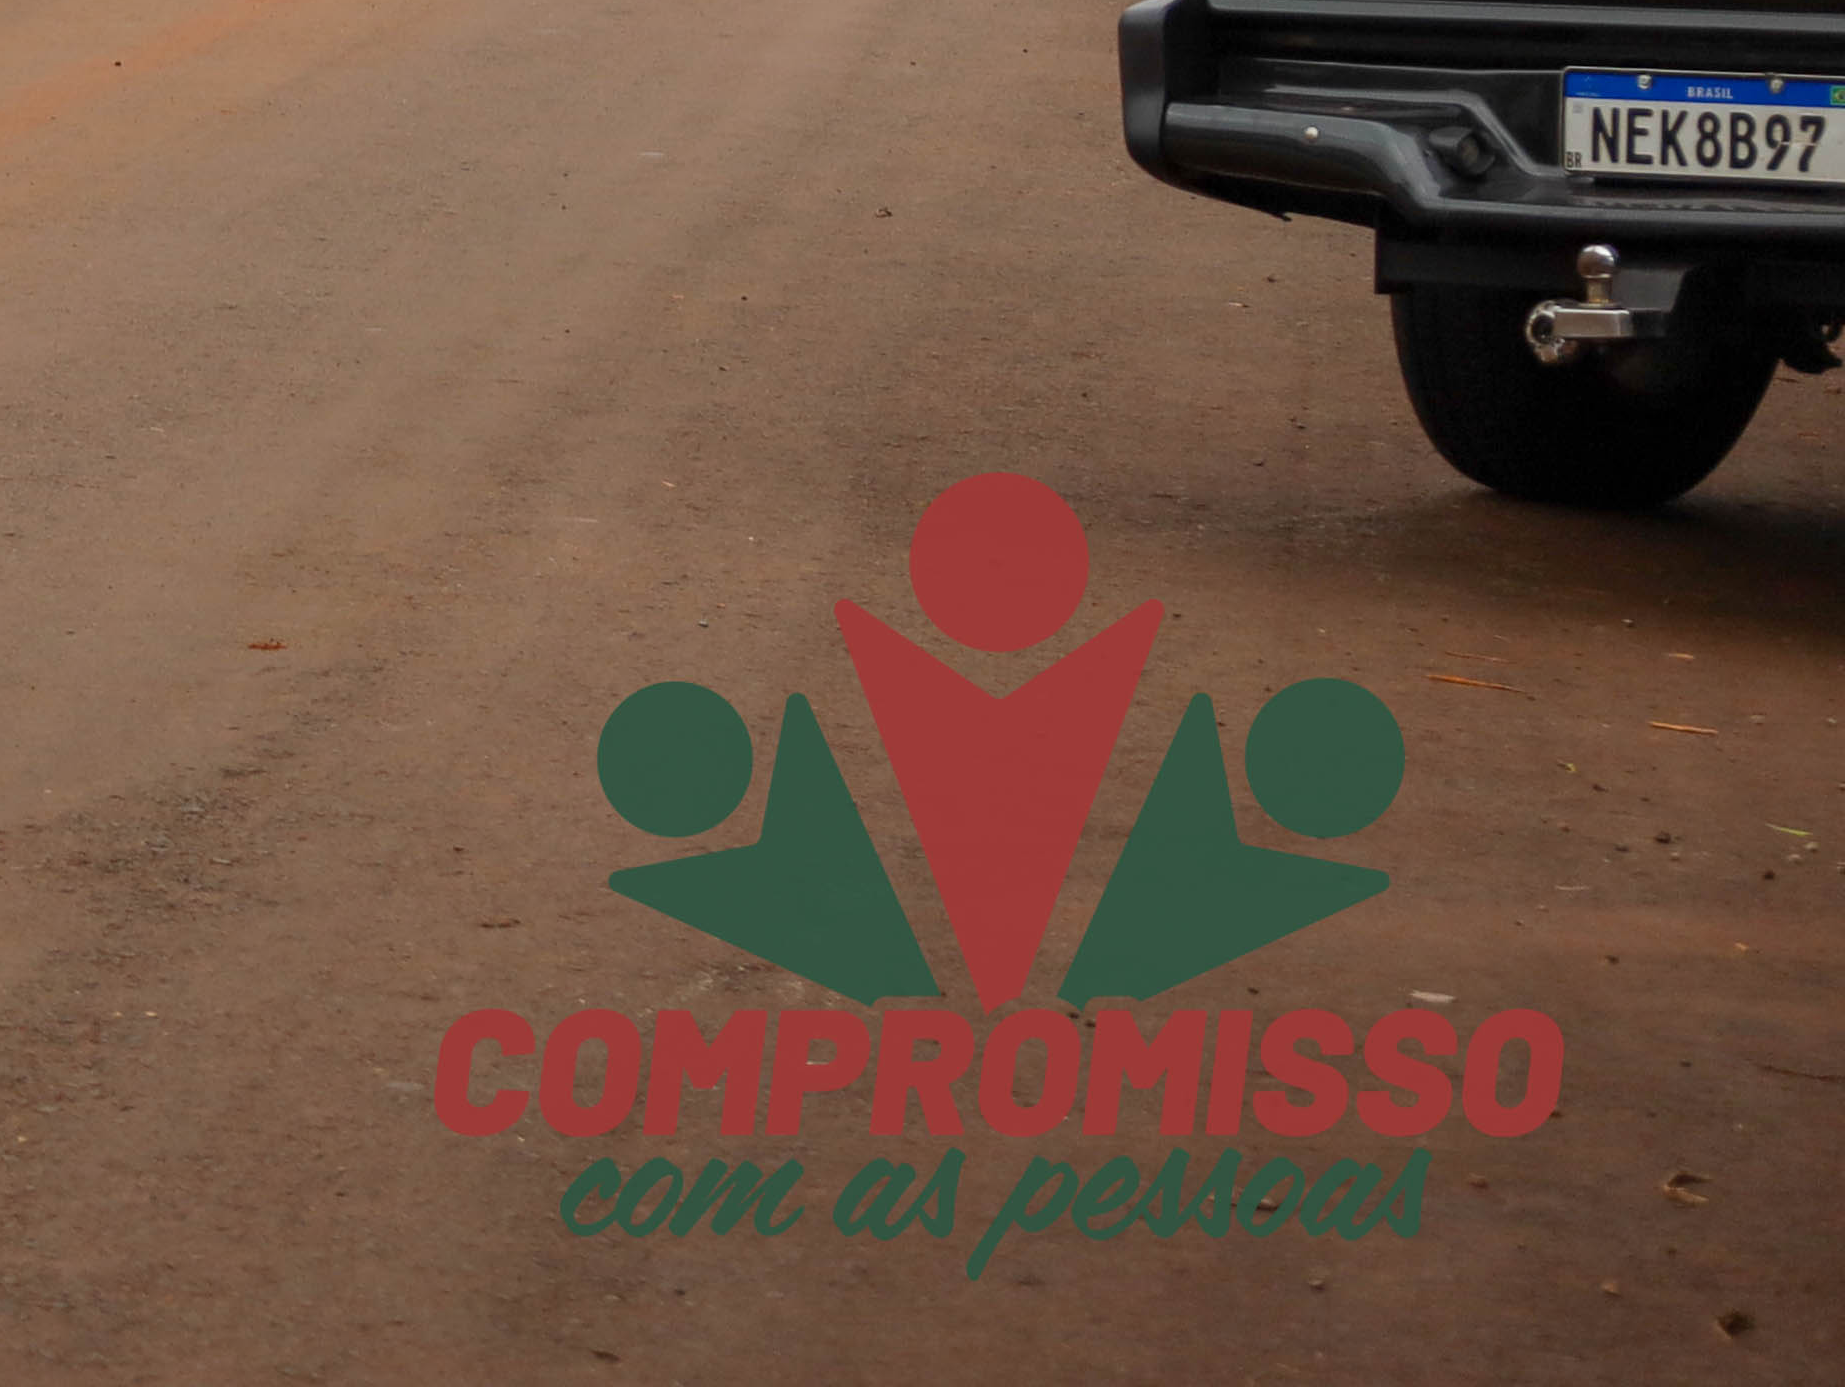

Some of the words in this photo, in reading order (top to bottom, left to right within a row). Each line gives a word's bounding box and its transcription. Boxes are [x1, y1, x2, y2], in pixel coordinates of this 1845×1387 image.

[1687, 85, 1734, 100] BRASIL
[1590, 106, 1826, 173] NEK8B97
[1565, 151, 1582, 169] BR
